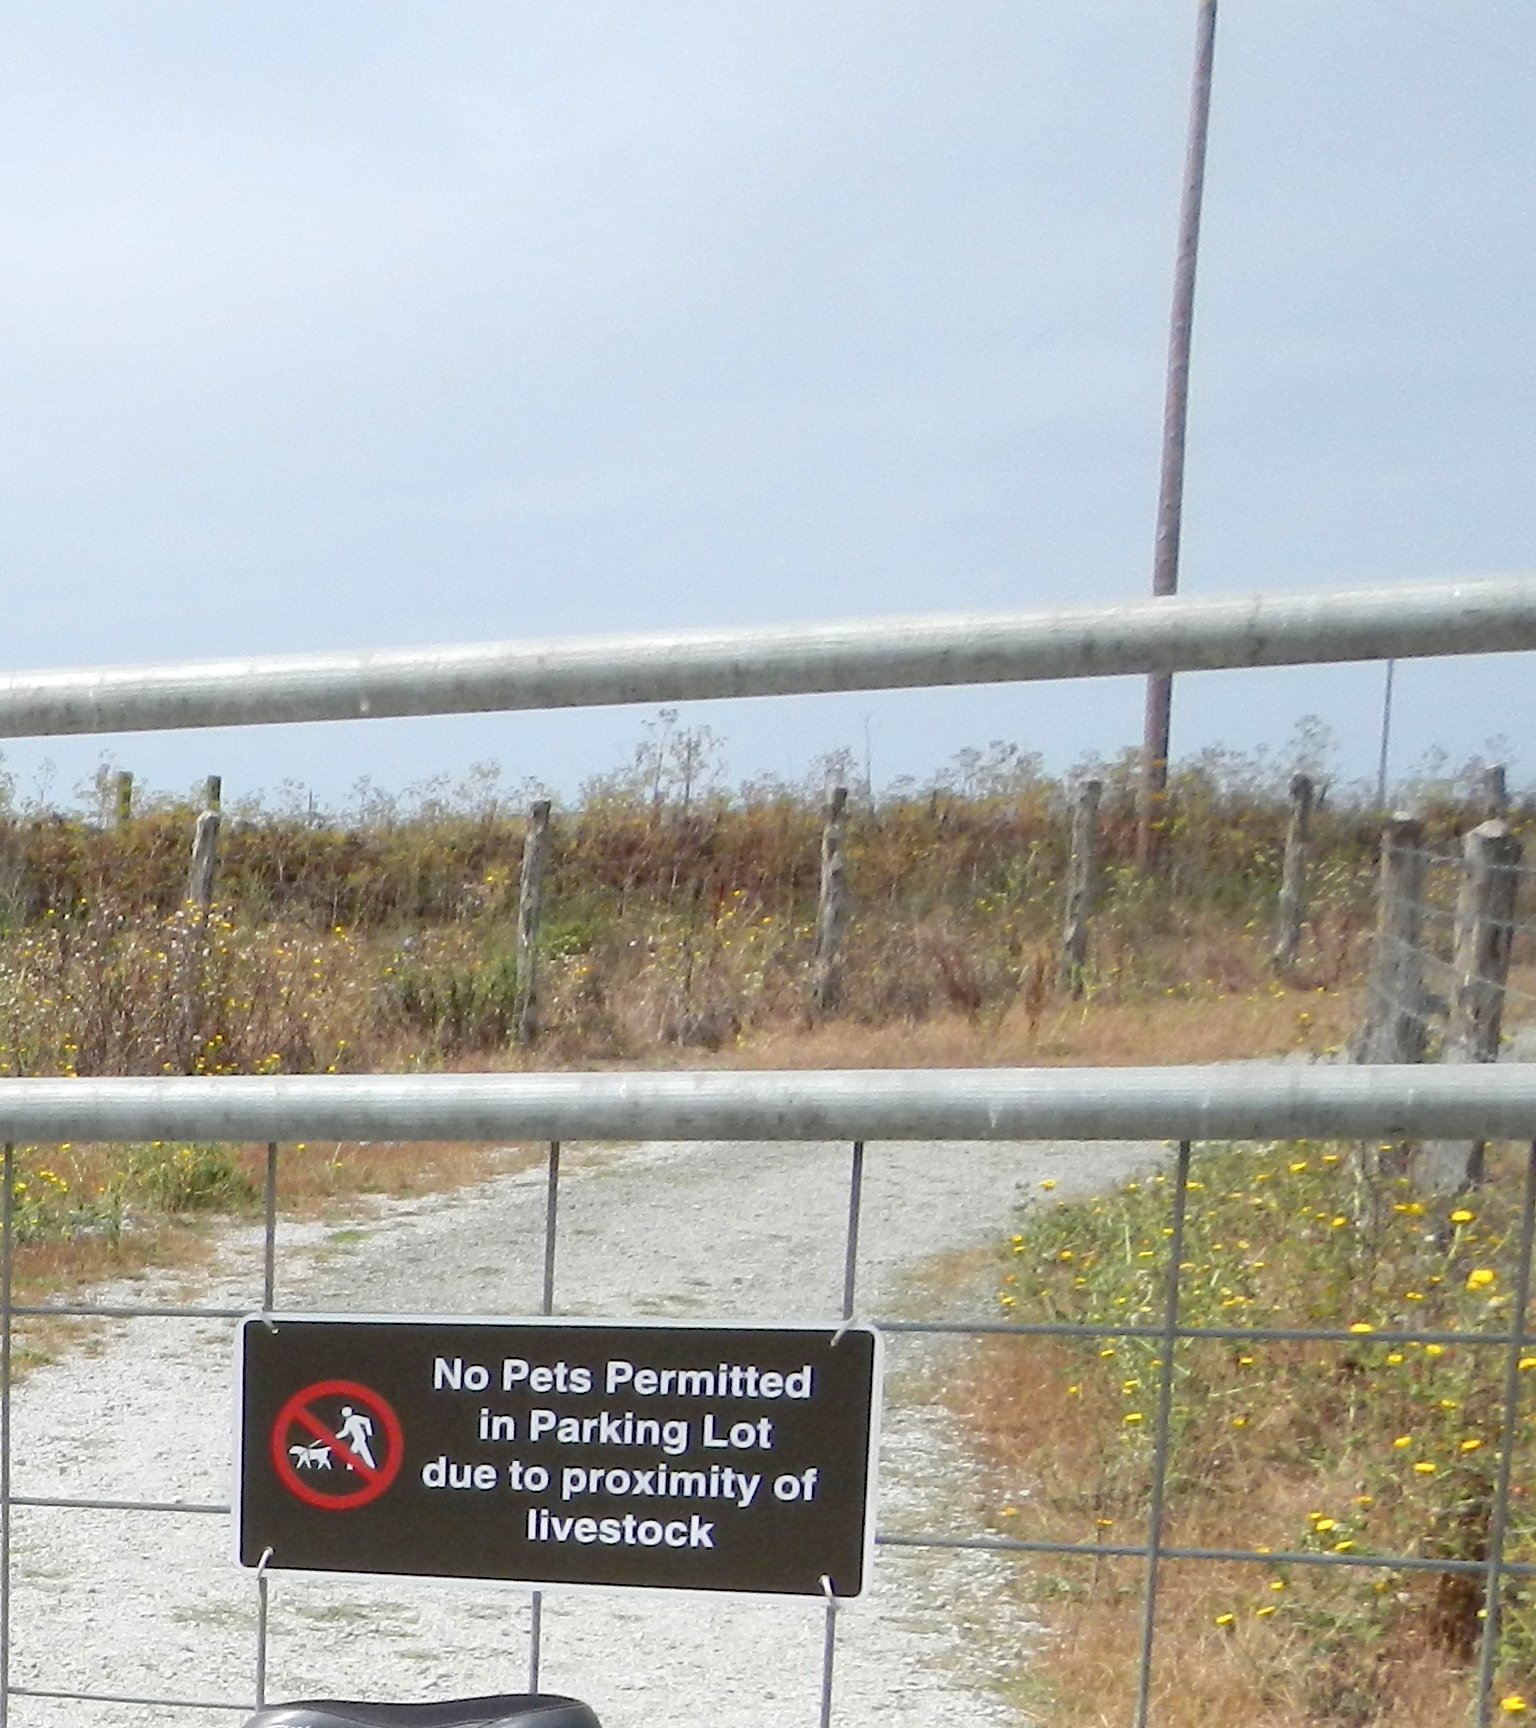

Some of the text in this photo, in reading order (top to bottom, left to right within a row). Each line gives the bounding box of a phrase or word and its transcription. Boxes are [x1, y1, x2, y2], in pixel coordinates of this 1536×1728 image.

[433, 1357, 813, 1400] No Pets Permitted
[480, 1409, 772, 1455] in Parking Lot
[422, 1457, 818, 1509] due to proximity of
[527, 1509, 716, 1549] livestock
